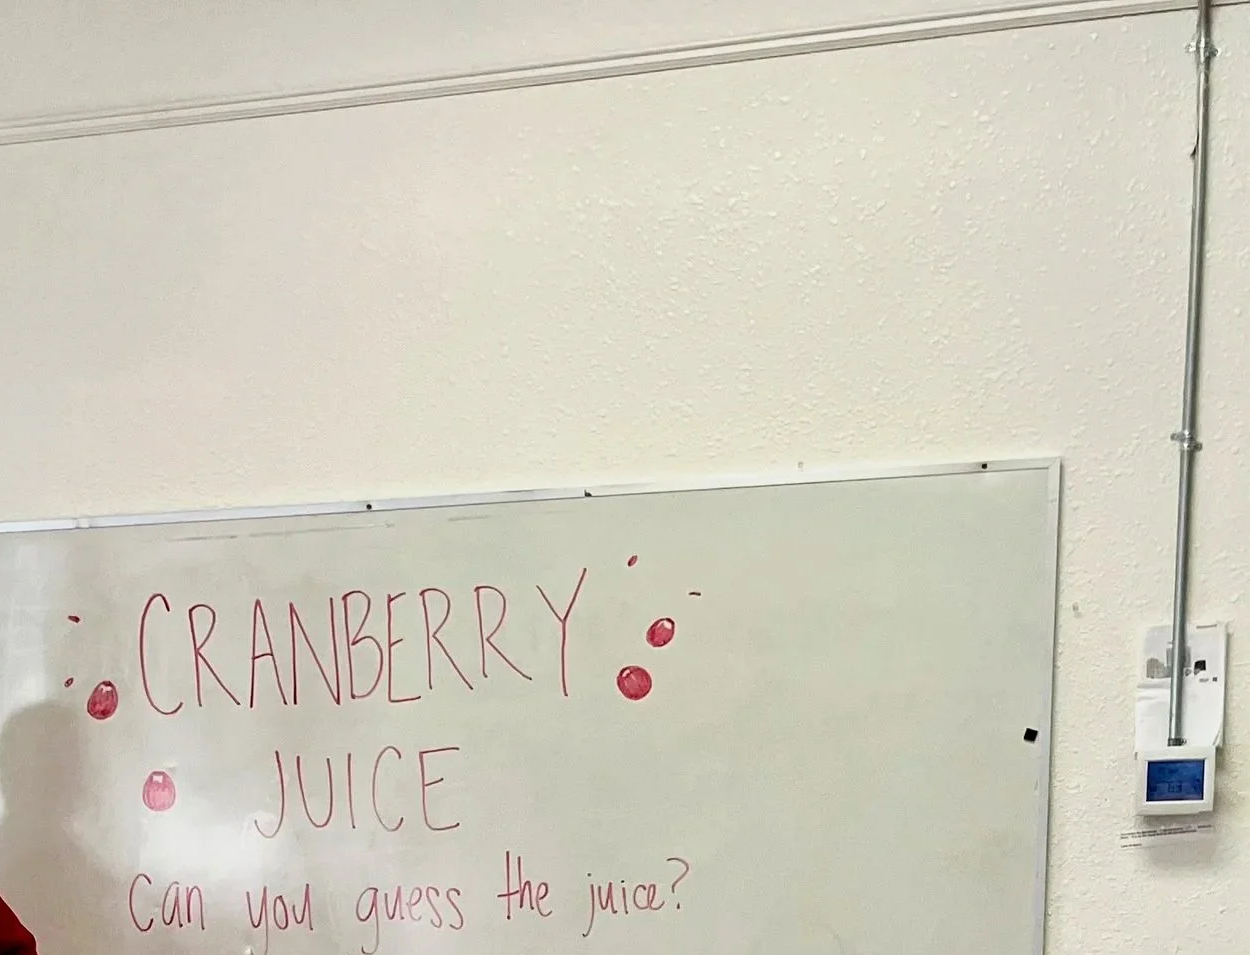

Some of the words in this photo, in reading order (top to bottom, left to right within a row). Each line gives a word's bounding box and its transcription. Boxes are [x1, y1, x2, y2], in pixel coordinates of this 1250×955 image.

[140, 568, 587, 715] CRANBERRY
[255, 746, 460, 838] JUICE
[129, 874, 205, 932] Can
[356, 886, 463, 955] guess
[497, 851, 553, 921] the
[582, 857, 690, 938] juice?
